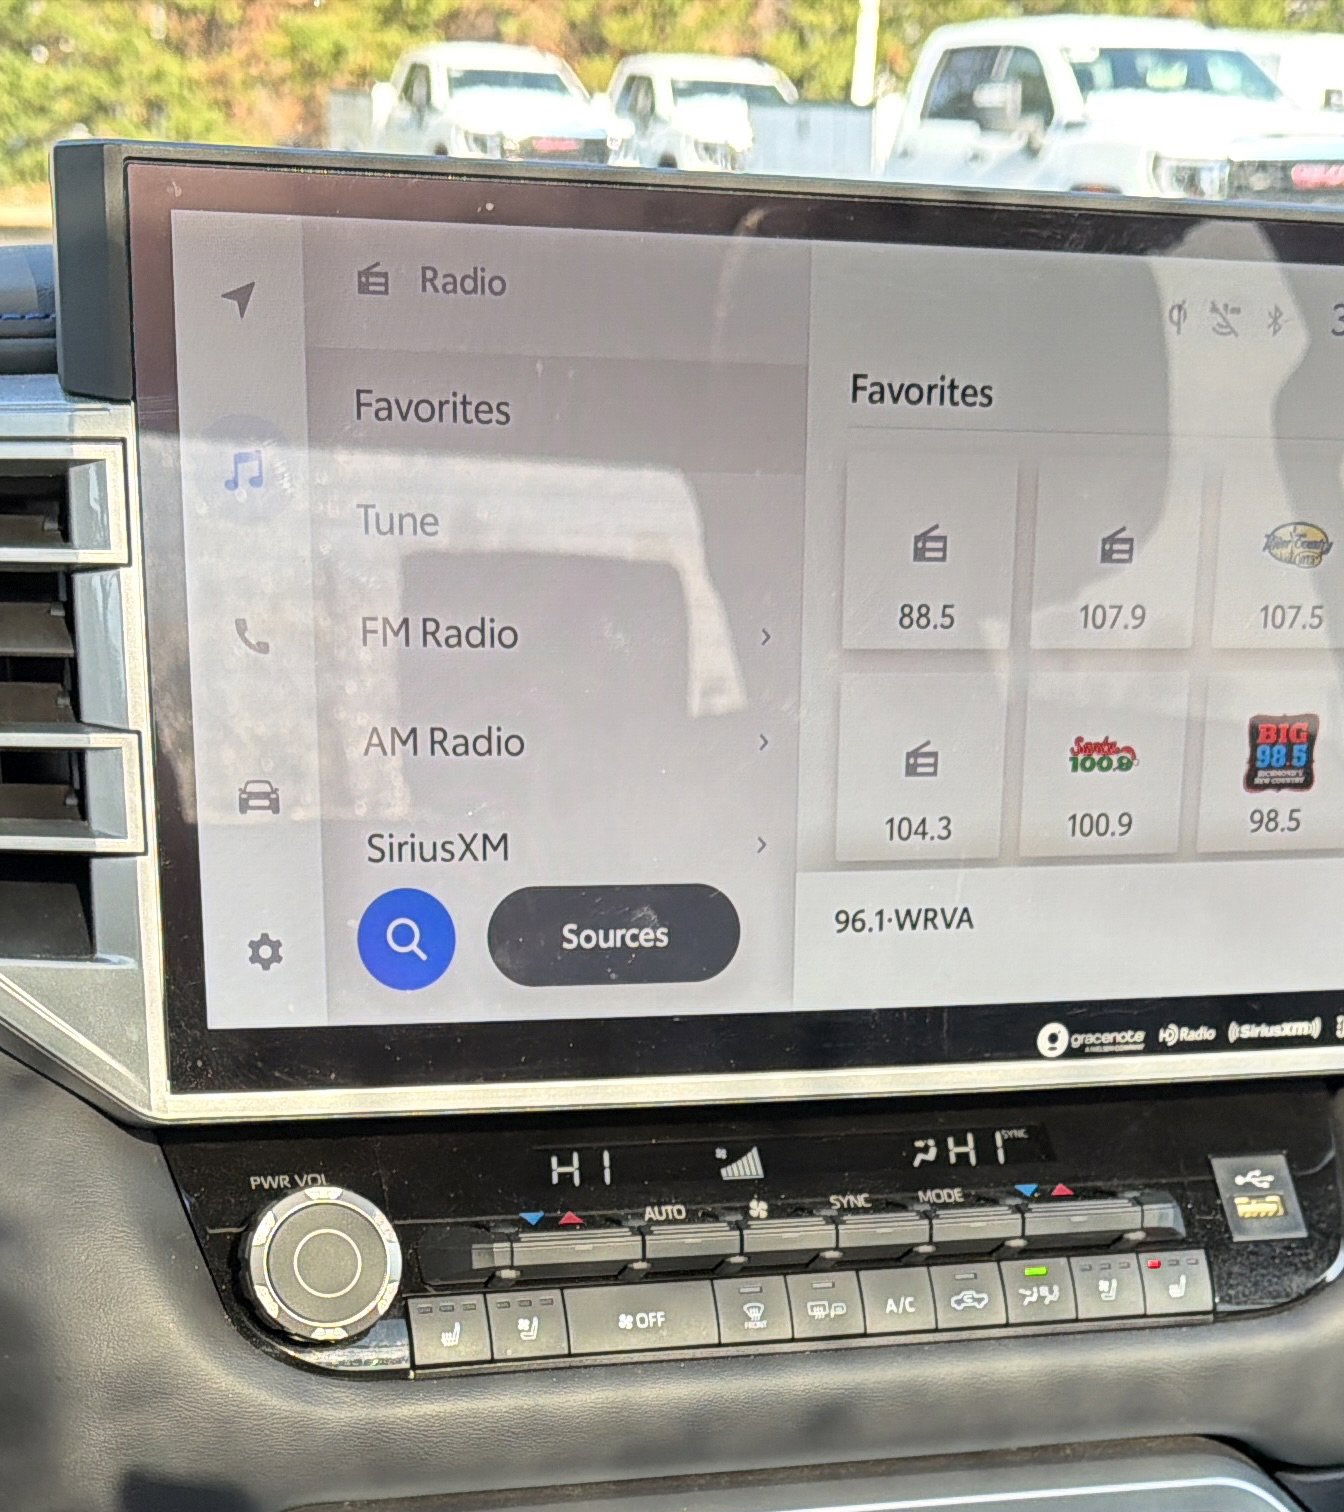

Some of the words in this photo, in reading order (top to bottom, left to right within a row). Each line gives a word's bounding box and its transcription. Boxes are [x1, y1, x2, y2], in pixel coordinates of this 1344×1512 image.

[420, 266, 507, 297] Radio
[850, 374, 994, 409] Favorites
[355, 389, 512, 426] Favorites
[357, 504, 440, 537] Tune
[898, 604, 955, 630] 88.5
[1079, 604, 1146, 631] 107.9
[1260, 604, 1324, 630] 107.5
[362, 617, 410, 648] FM
[422, 617, 519, 650] Radio
[363, 727, 419, 757] AM
[429, 727, 526, 758] Radio
[1257, 722, 1309, 744] BIG
[1069, 755, 1133, 773] 100.9
[1255, 744, 1309, 768] 98.5
[884, 815, 952, 842] 104.3
[1068, 812, 1133, 838] 100.9
[1249, 808, 1301, 833] 98.5
[367, 832, 510, 864] SiriusXM
[561, 923, 669, 950] Sources
[1071, 1029, 1146, 1048] gracenote
[1180, 1025, 1217, 1042] Radio
[250, 1174, 291, 1190] PWR
[828, 1193, 872, 1210] SYNC
[917, 1187, 965, 1204] MODE
[644, 1204, 687, 1222] AUTO
[885, 1296, 916, 1316] A/C
[635, 1311, 666, 1329] OFF
